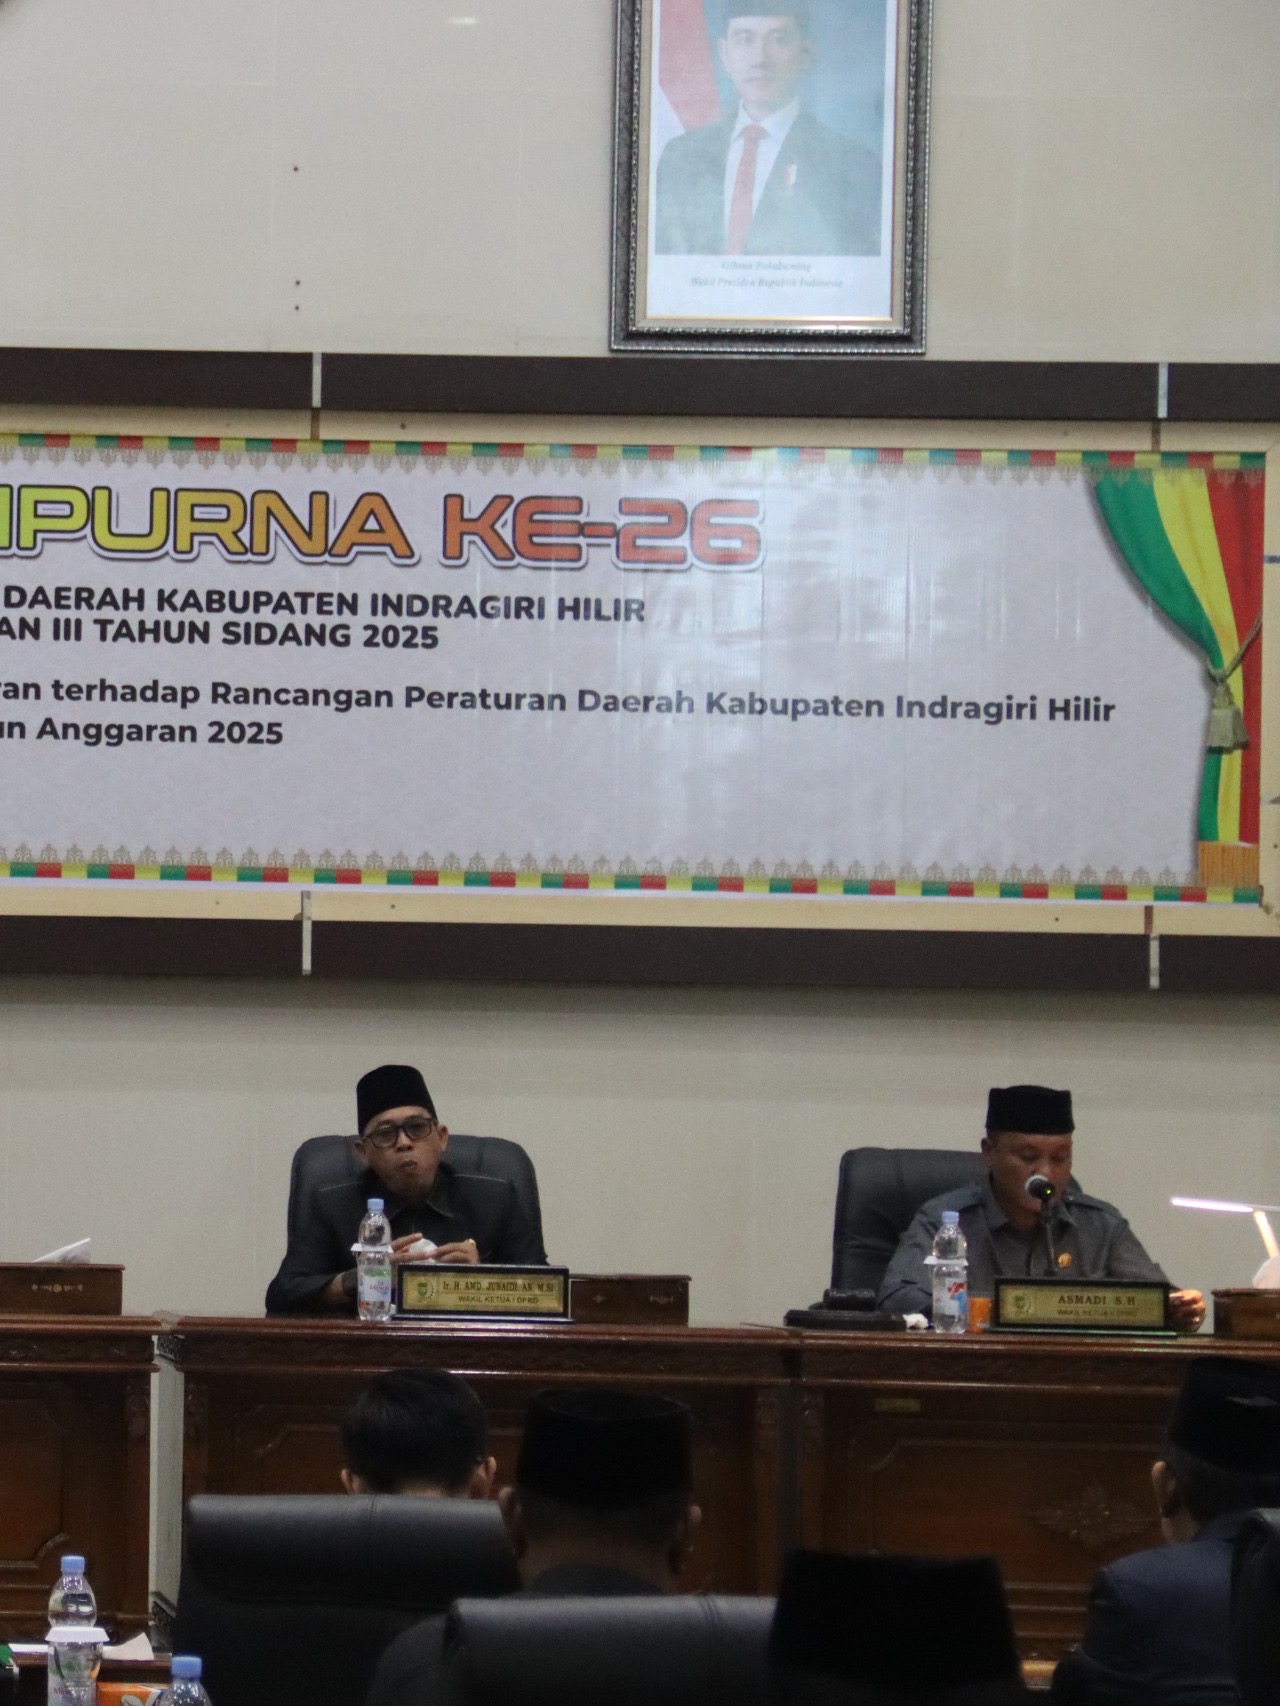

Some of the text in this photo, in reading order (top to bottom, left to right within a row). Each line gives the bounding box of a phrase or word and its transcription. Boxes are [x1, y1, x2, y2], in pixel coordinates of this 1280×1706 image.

[442, 494, 762, 565] KE-26
[3, 584, 146, 612] DAERAH
[156, 588, 359, 617] KABUPATEN
[370, 592, 546, 621] INDRAGIRI
[557, 596, 646, 623] HILIR
[52, 616, 83, 642] III
[92, 618, 211, 645] TAHUN
[221, 620, 351, 648] SIDANG
[362, 623, 439, 650] 2025
[50, 677, 201, 710] terhadap
[211, 681, 394, 714] Rancangan
[404, 685, 567, 712] Peraturan
[578, 689, 694, 714] Daerah
[706, 691, 885, 722] Kabupaten
[896, 694, 1038, 726] Indragiri
[1048, 695, 1116, 722] Hilir
[35, 717, 198, 748] Anggaran
[207, 720, 284, 745] 2025
